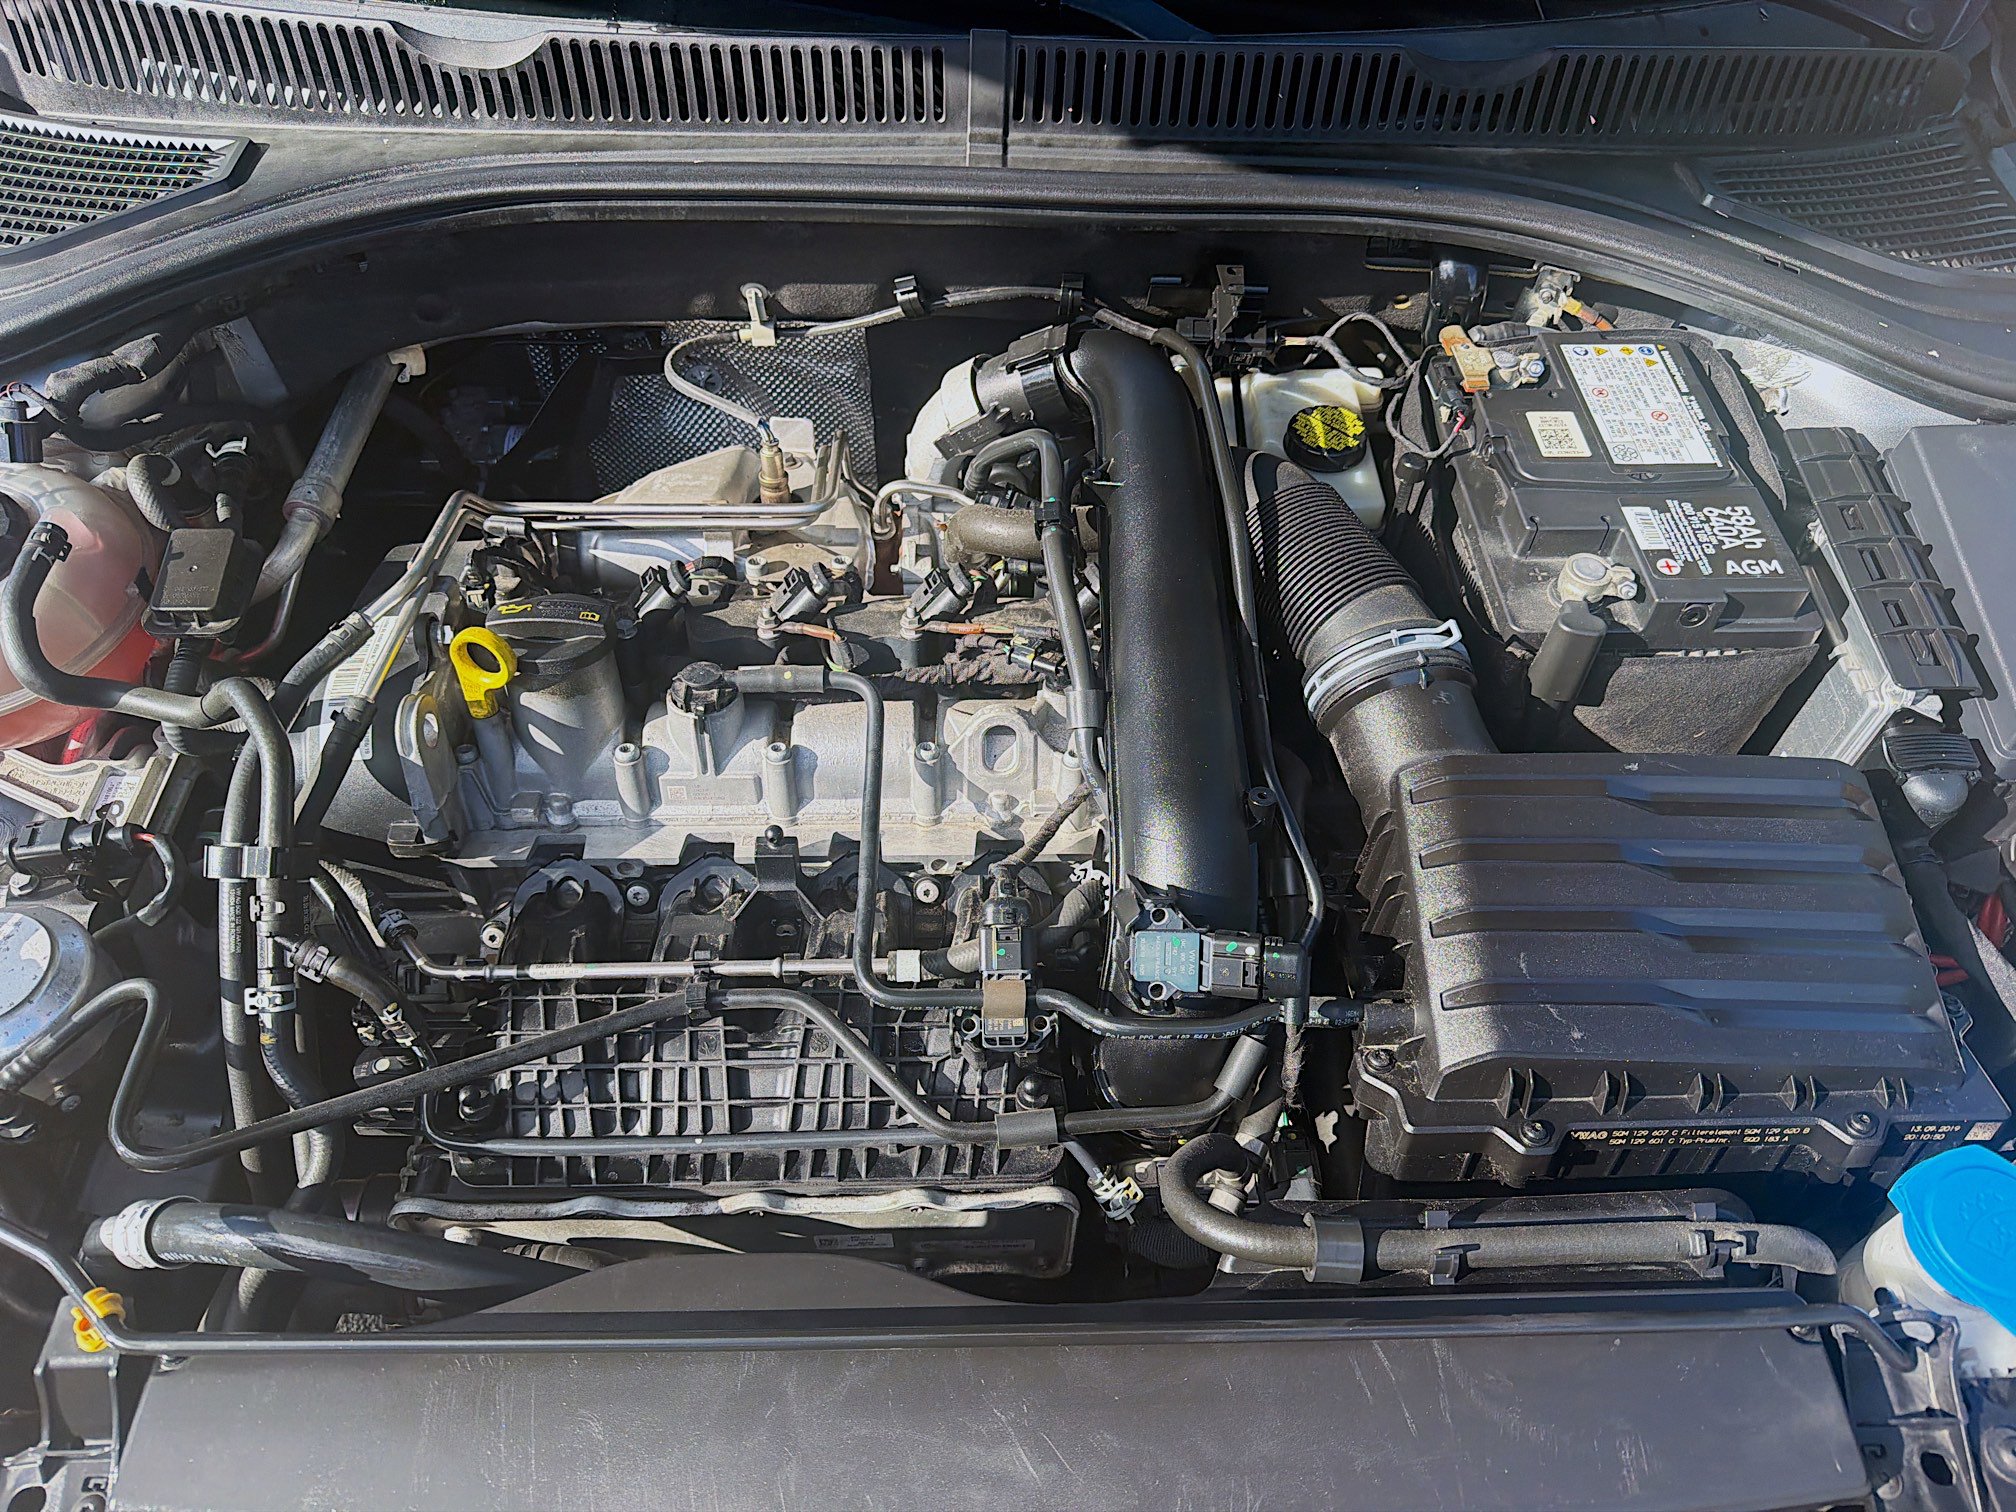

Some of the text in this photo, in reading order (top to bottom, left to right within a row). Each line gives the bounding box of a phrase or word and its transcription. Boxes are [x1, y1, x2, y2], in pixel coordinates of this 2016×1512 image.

[1702, 507, 1744, 550] 640A
[1725, 506, 1766, 549] 58Ah
[1726, 559, 1784, 575] AGM
[1188, 949, 1196, 976] VW AG
[1680, 1129, 1742, 1137] Filterelement
